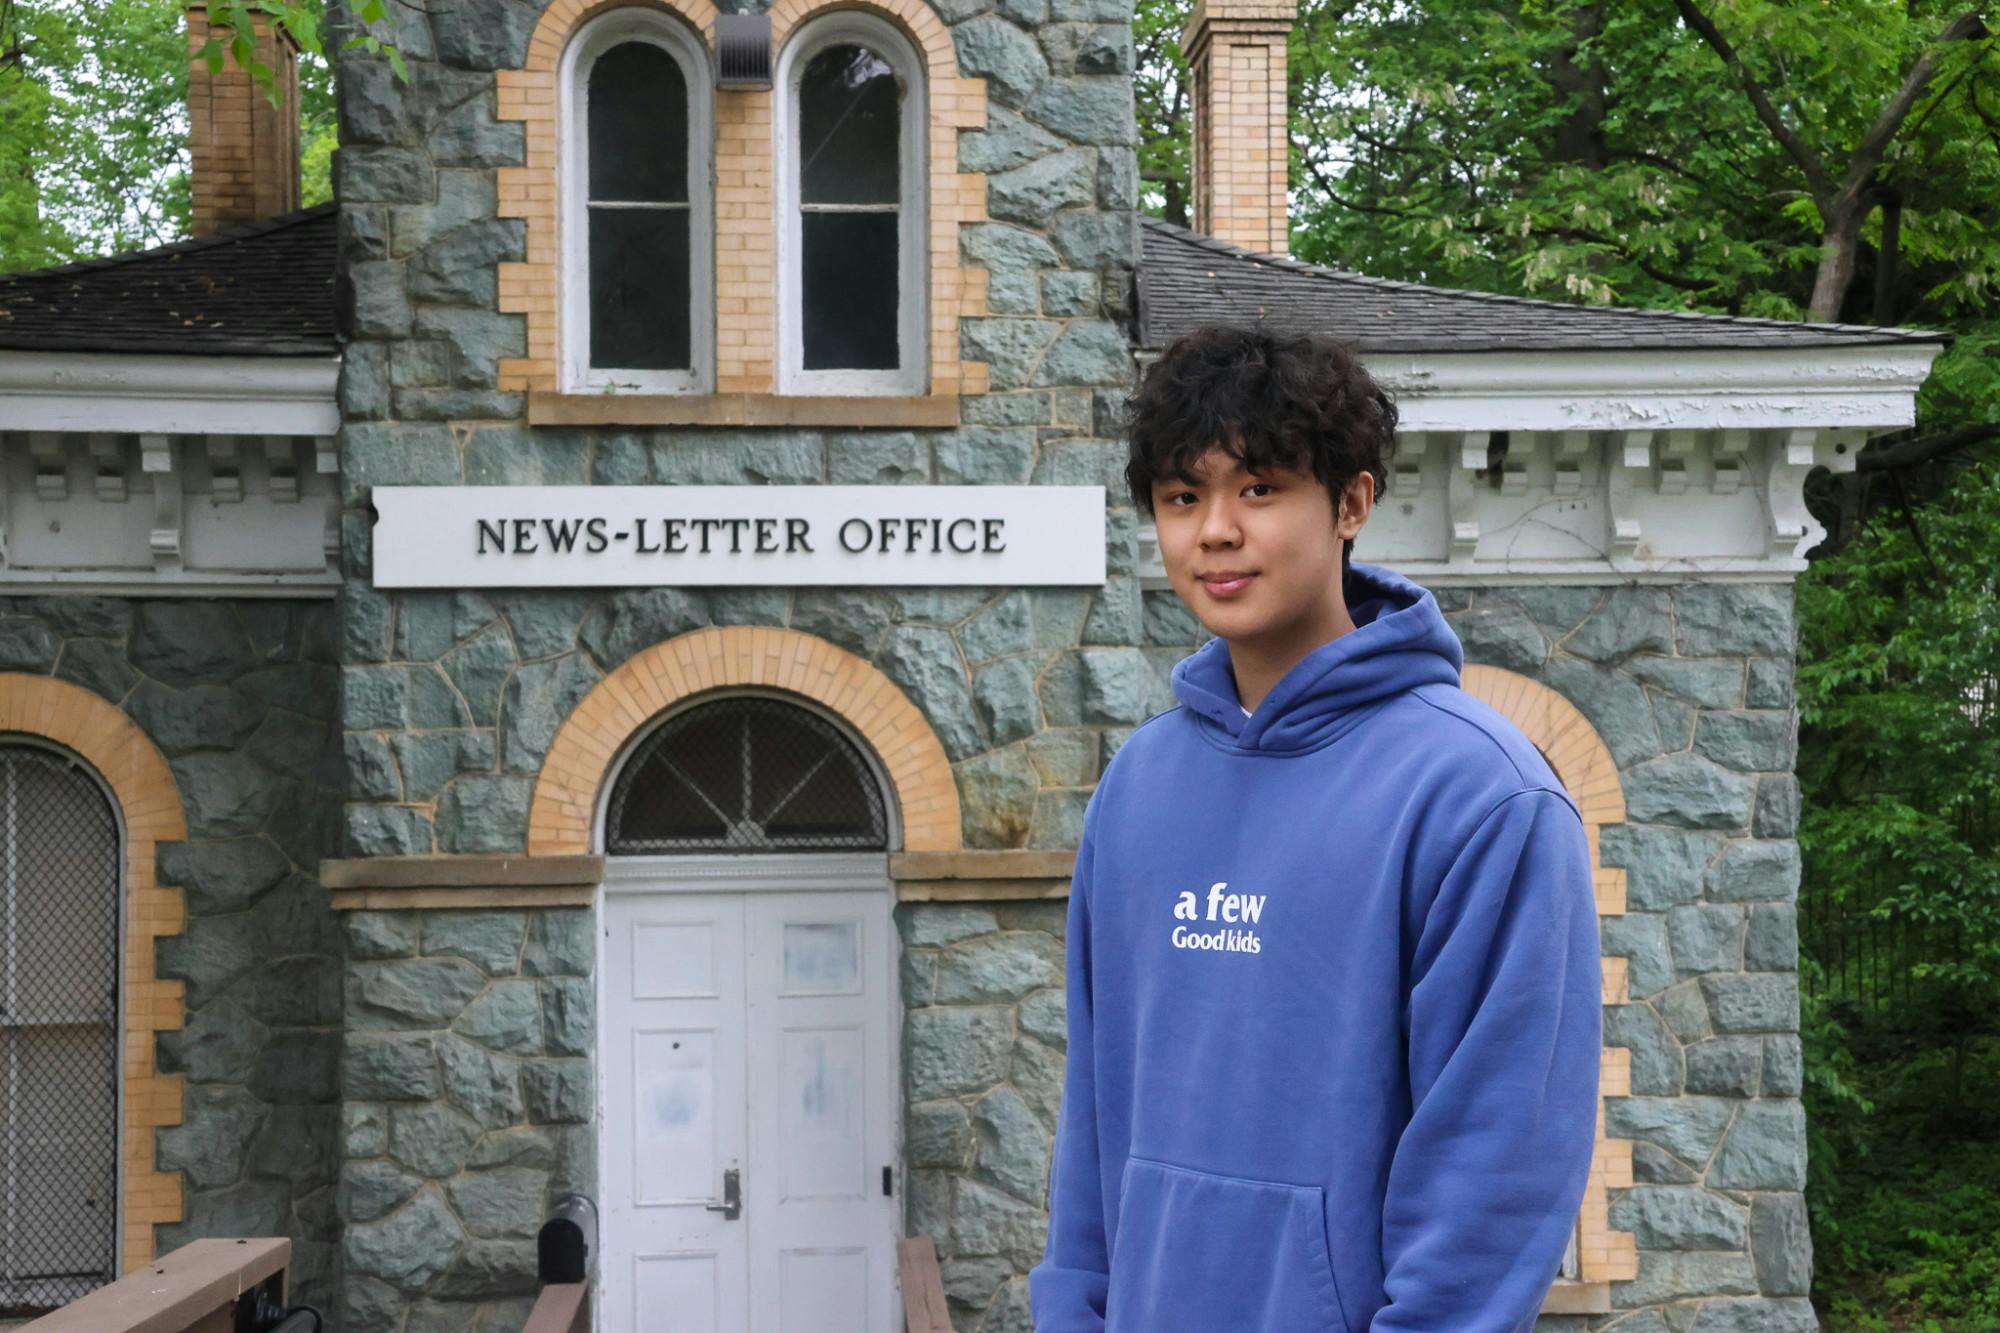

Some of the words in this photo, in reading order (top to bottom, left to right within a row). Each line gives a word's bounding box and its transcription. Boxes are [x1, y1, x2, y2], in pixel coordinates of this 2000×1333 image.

[477, 518, 814, 555] NEWS-LETTER
[838, 518, 1006, 555] OFFICE
[1173, 890, 1198, 921] a
[1206, 882, 1266, 924] few
